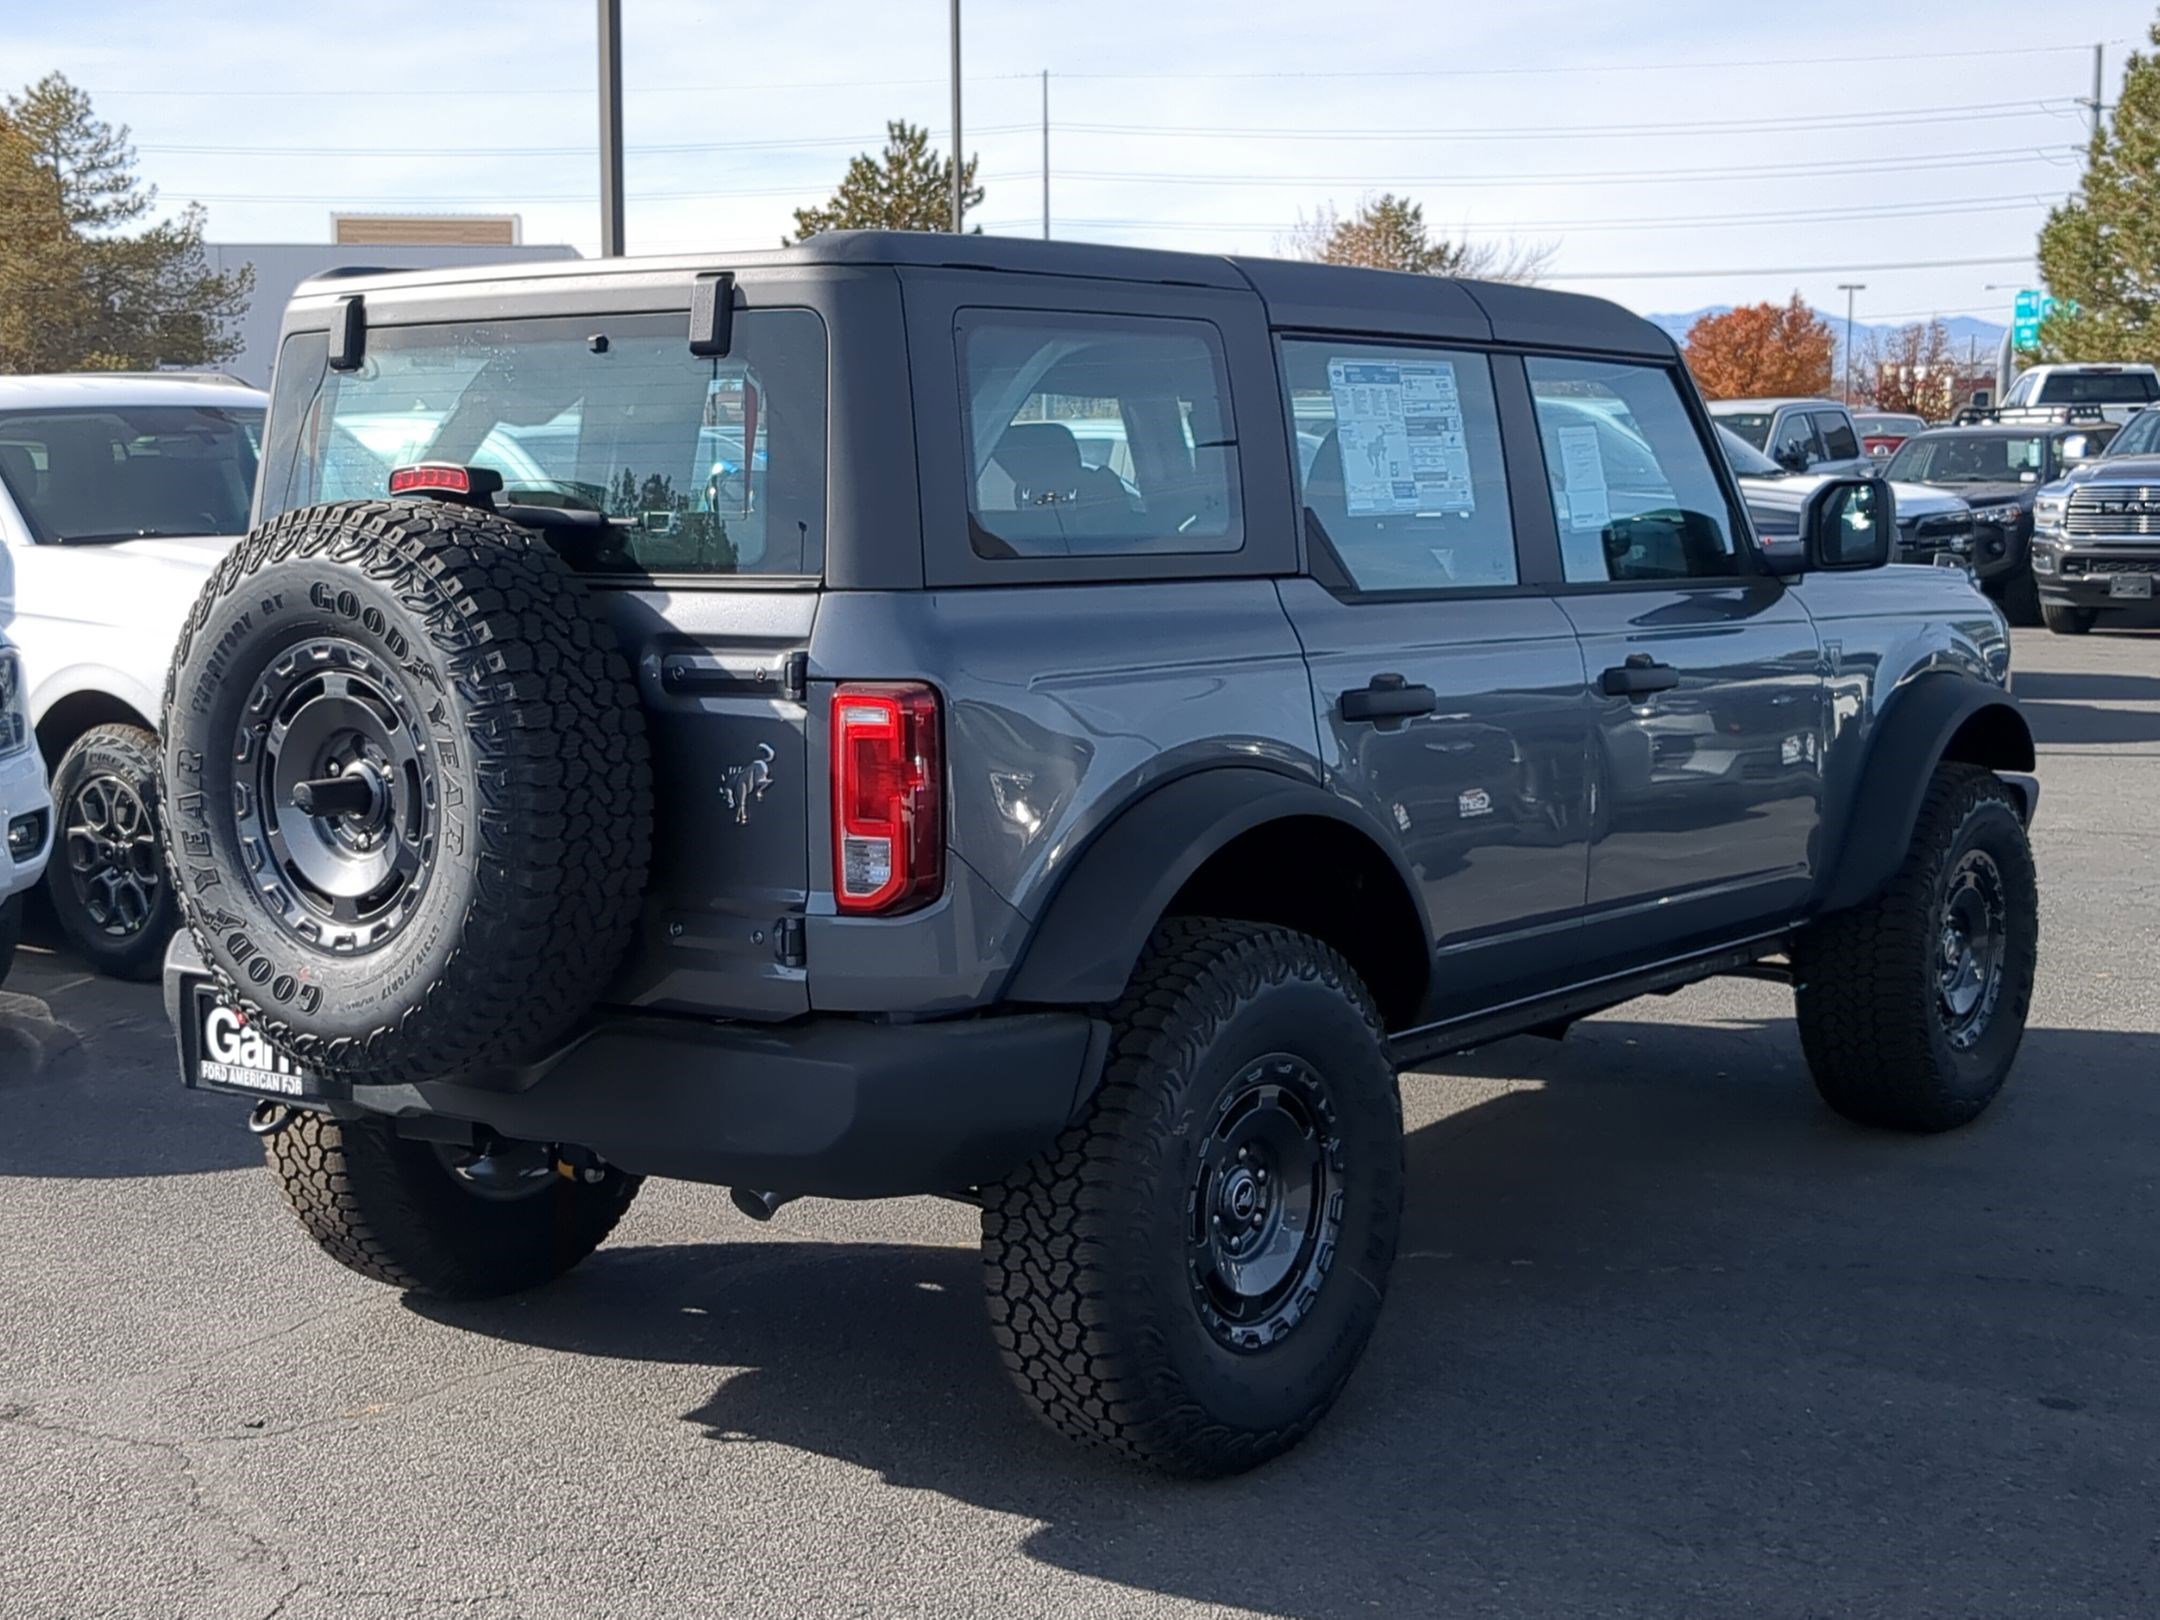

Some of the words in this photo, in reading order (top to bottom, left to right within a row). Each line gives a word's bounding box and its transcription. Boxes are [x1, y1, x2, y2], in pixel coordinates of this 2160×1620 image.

[191, 611, 253, 715] TERRITORY
[309, 580, 465, 858] GOODYEAR
[176, 748, 324, 1018] GOODYEAR
[201, 1061, 228, 1082] FORD
[228, 1066, 281, 1092] AMERICAN
